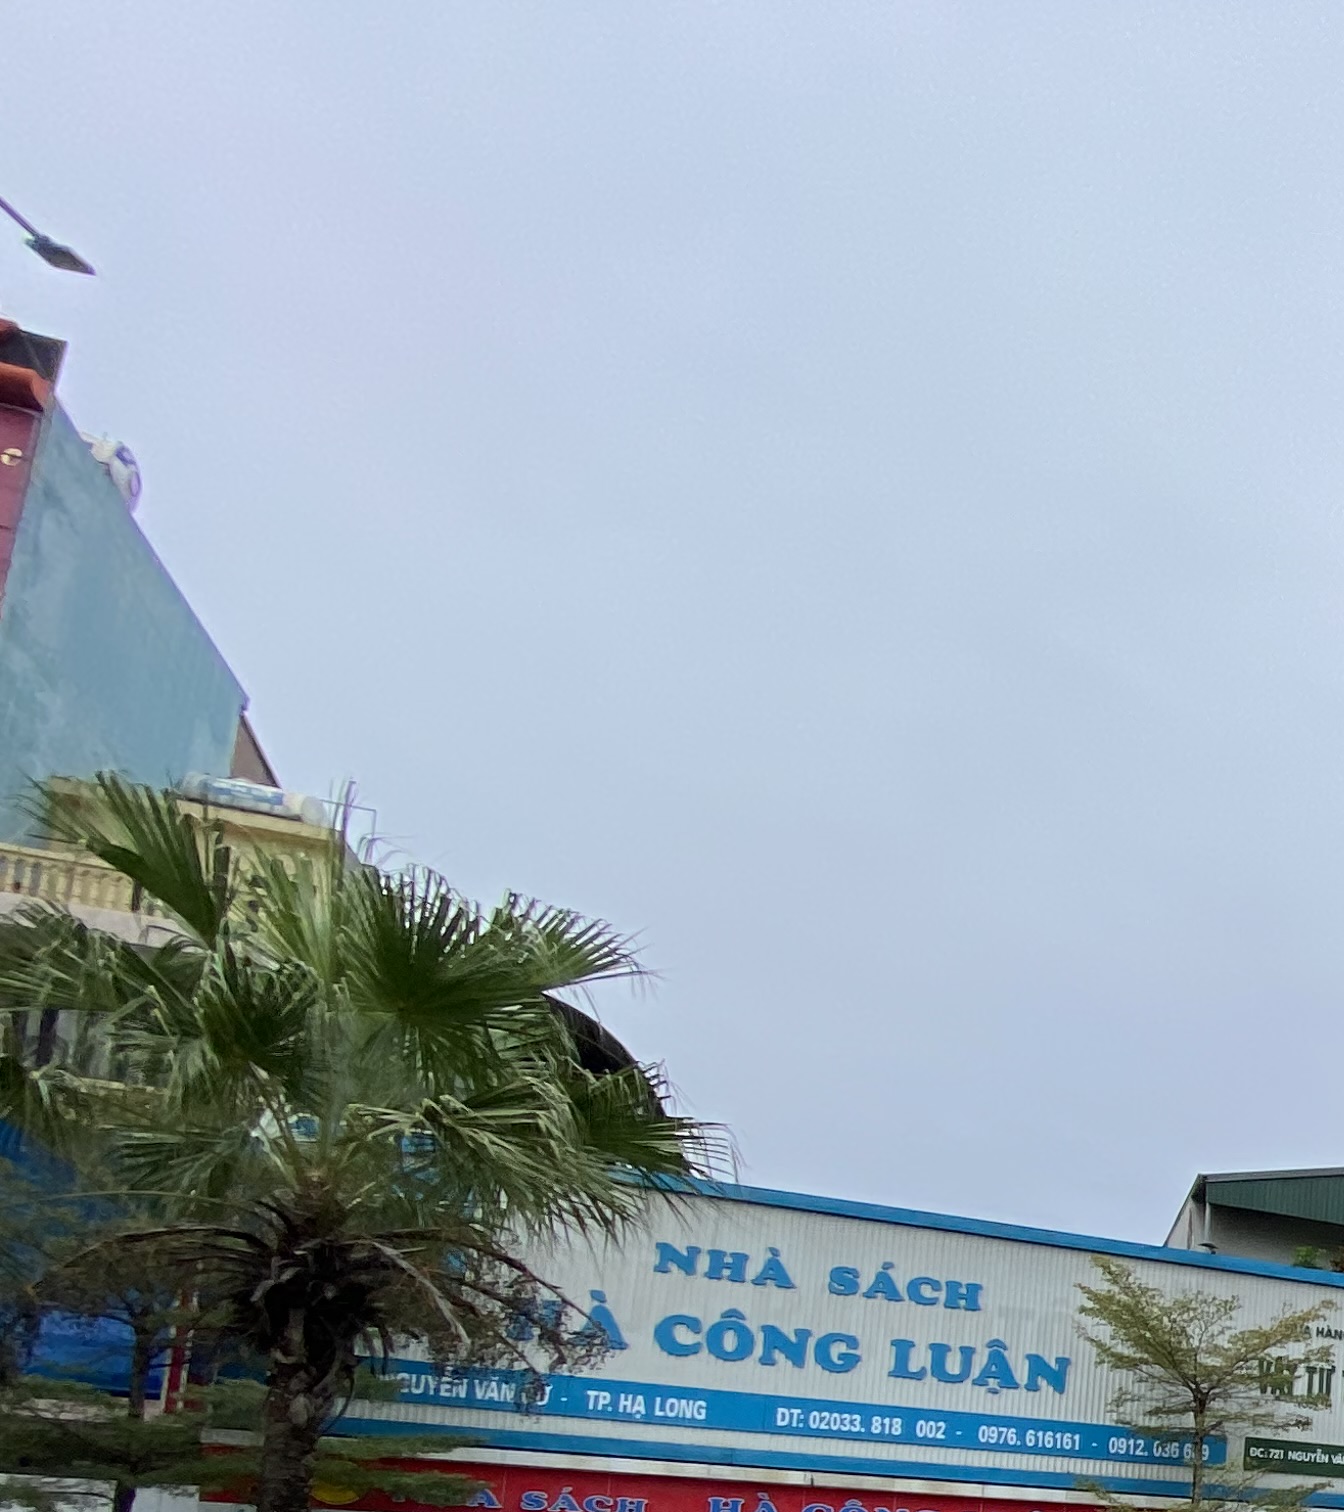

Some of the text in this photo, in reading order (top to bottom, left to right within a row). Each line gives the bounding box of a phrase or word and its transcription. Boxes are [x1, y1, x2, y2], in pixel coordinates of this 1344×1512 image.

[653, 1241, 984, 1312] NHÀ SÁCH
[504, 1288, 1071, 1395] À CÔNG LUẬN
[474, 1376, 517, 1403] VĂN
[586, 1389, 613, 1412] TP.
[617, 1393, 646, 1417] HẠ
[653, 1396, 707, 1421] LONG
[871, 1415, 903, 1436] 818
[915, 1418, 947, 1440] 002
